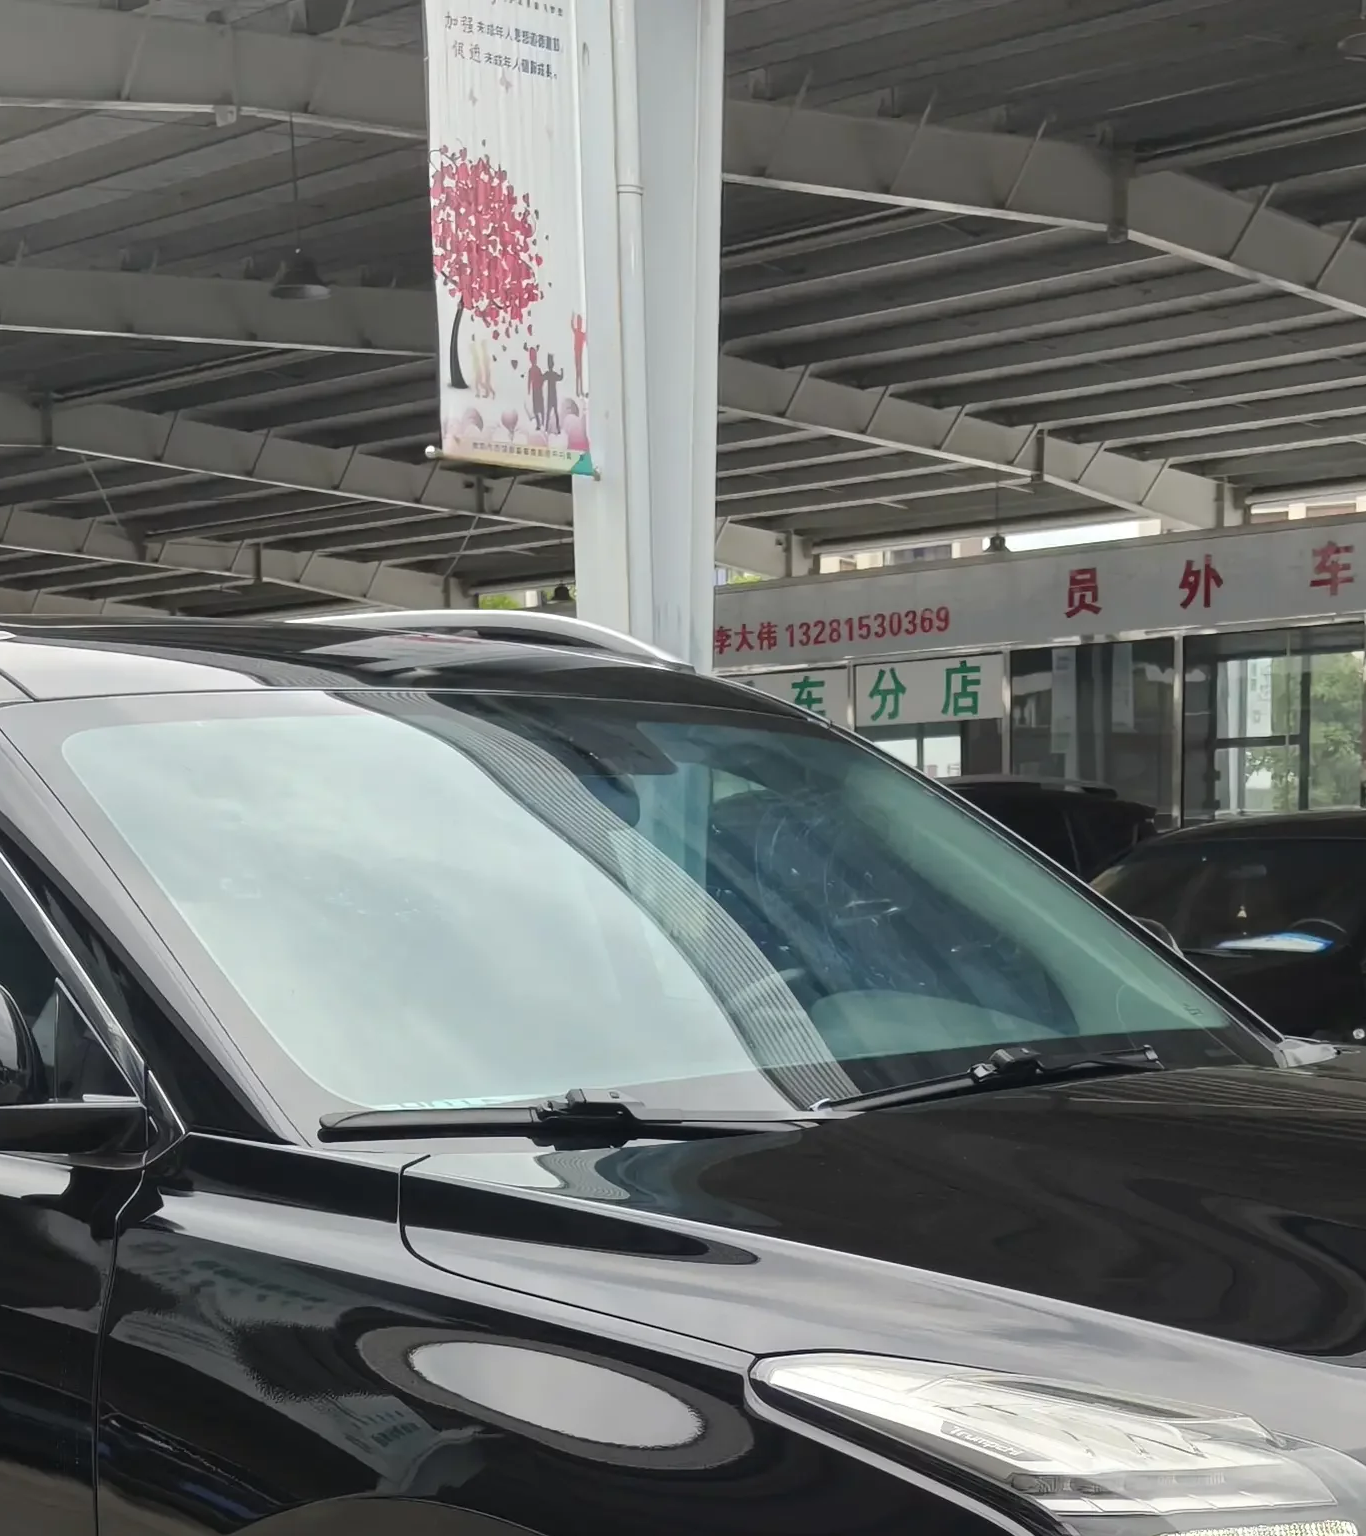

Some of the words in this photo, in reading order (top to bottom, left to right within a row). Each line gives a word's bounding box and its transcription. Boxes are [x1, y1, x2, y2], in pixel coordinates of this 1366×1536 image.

[714, 621, 778, 655] 李大伟
[785, 605, 951, 648] 13281530369
